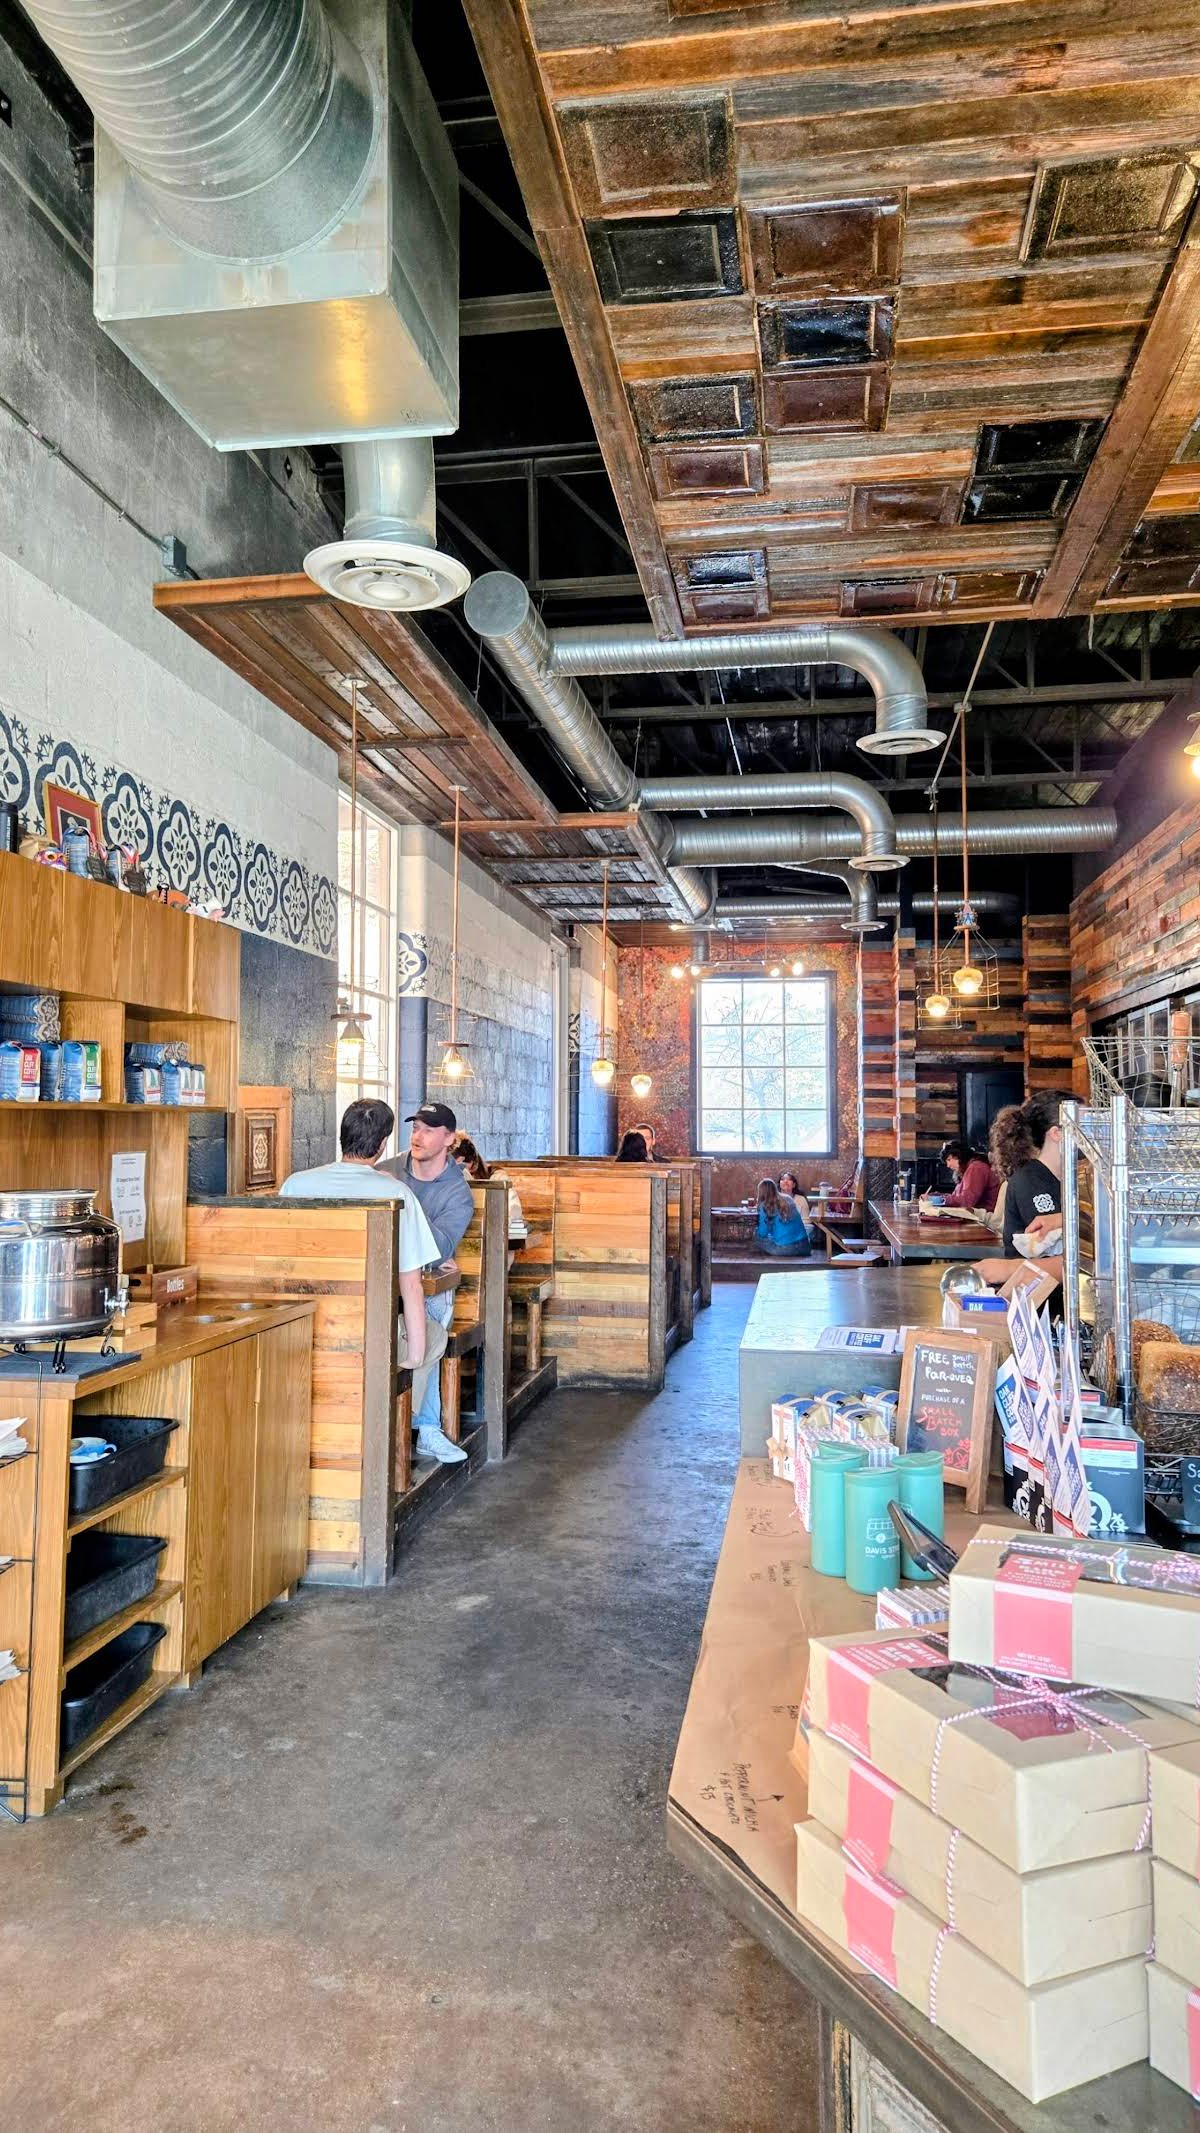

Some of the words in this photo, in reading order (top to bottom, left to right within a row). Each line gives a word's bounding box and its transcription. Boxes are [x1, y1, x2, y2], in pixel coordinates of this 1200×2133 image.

[167, 1276, 184, 1293] Bottles
[921, 1350, 950, 1365] FREE
[916, 1406, 954, 1423] SMALL
[926, 1416, 962, 1431] BATCH
[865, 1546, 887, 1555] DAVIS
